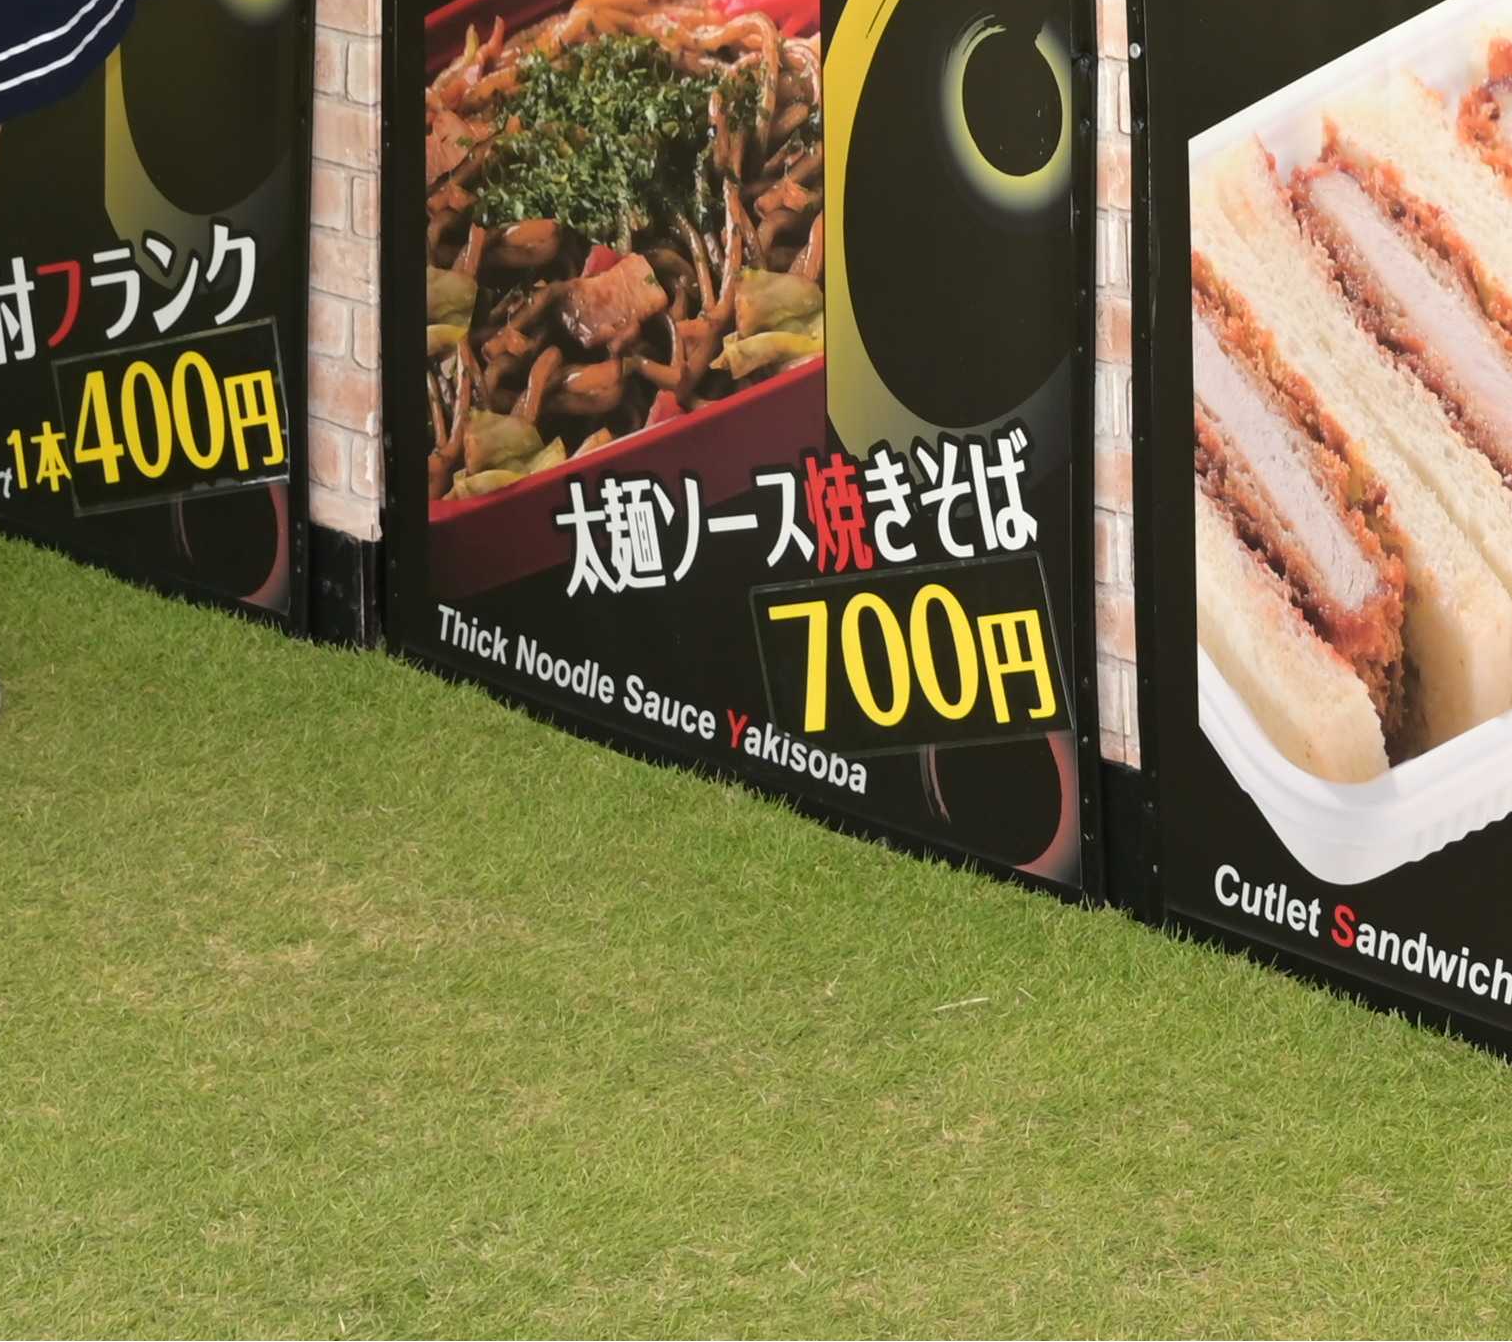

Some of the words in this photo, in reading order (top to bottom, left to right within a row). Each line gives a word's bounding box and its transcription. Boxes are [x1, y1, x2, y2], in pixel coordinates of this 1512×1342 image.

[555, 426, 1039, 598] 太麺ソース焼きそば
[438, 603, 508, 666] Thick
[516, 634, 616, 705] Noodle
[622, 673, 717, 741] Sauce
[725, 707, 869, 795] Yakisoba
[768, 583, 1058, 734] 700円
[1213, 862, 1322, 940] Cutlet
